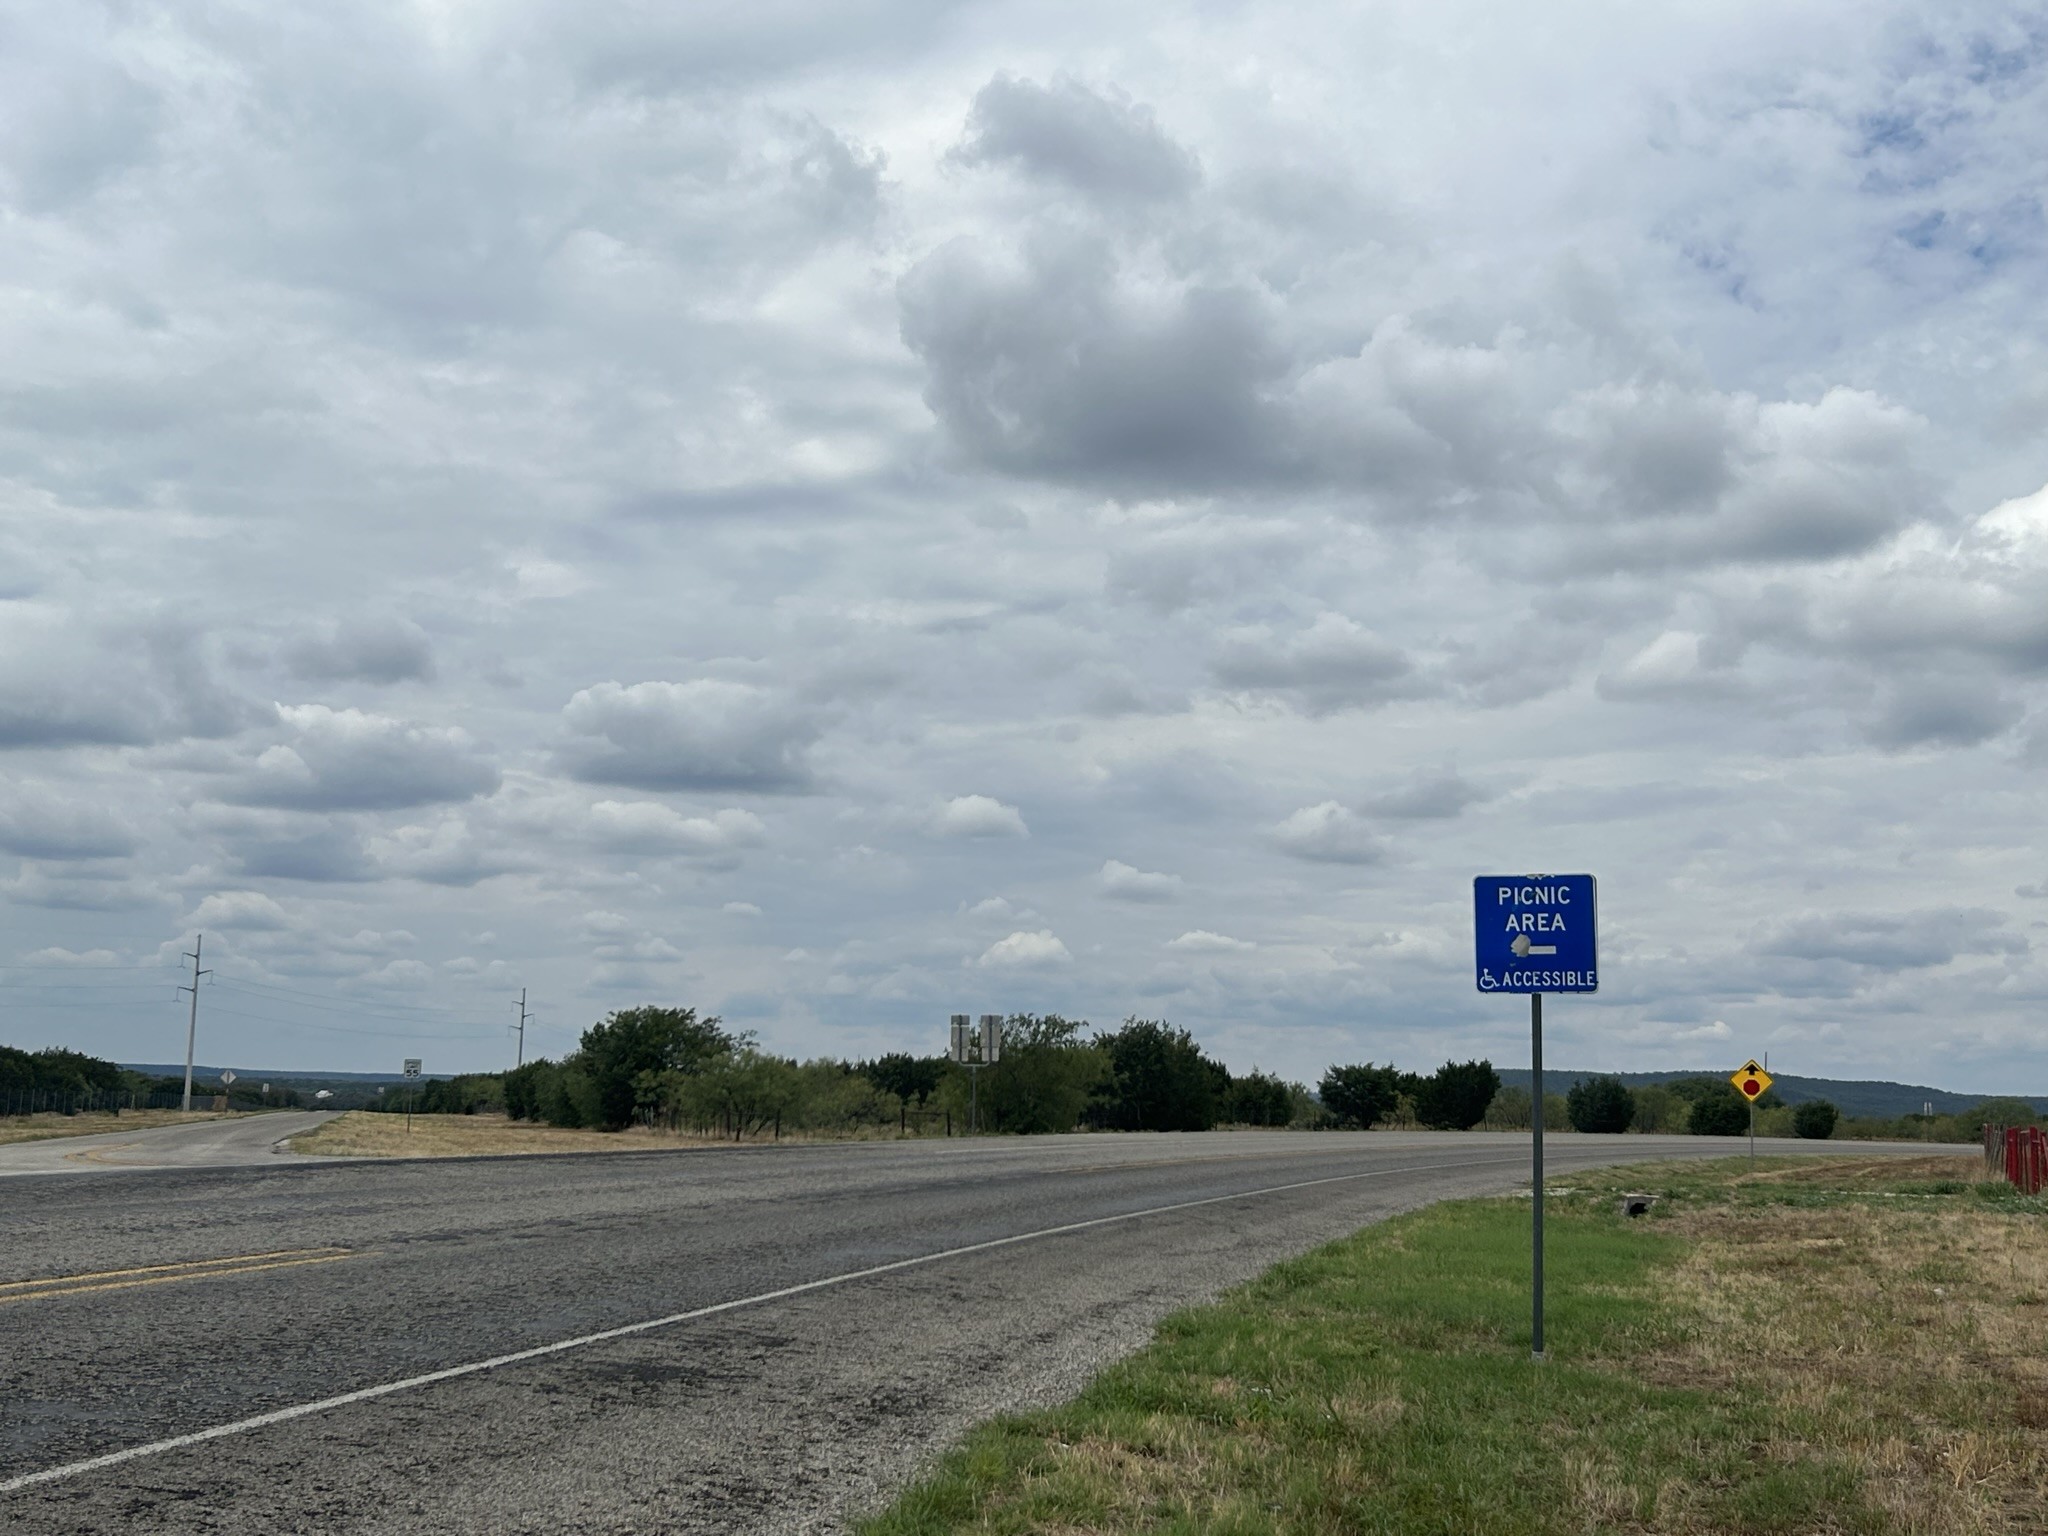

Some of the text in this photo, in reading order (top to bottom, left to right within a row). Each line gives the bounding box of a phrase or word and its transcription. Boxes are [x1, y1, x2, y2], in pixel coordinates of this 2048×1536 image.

[1498, 886, 1571, 905] PICNIC
[1505, 912, 1566, 932] AREA
[1502, 970, 1595, 986] ACCESSIBLE
[406, 1069, 419, 1077] 55
